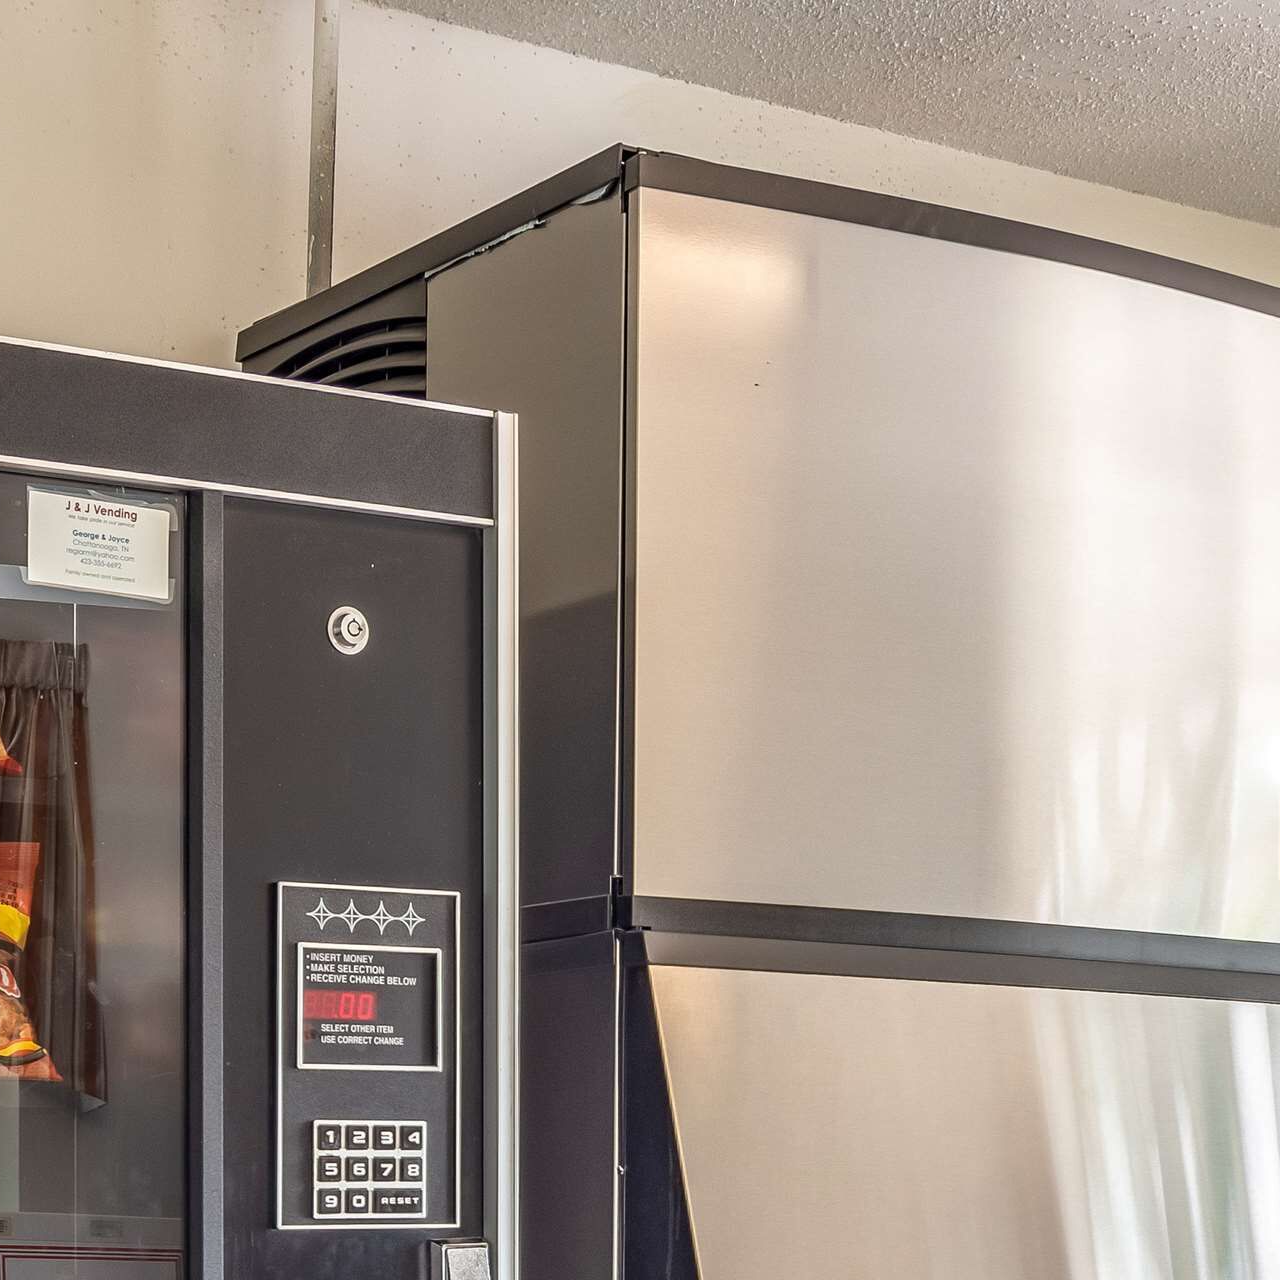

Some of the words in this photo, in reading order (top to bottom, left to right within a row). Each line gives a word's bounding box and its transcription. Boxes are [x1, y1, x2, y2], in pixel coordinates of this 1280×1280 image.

[65, 501, 71, 510] J
[74, 502, 81, 512] &
[84, 503, 90, 513] J
[94, 504, 138, 522] Vending
[72, 529, 99, 540] George
[108, 534, 130, 544] Joyce
[311, 953, 342, 962] INSERT
[343, 954, 374, 964] MONEY
[311, 963, 336, 973] MAKE
[337, 964, 385, 974] SELECTION
[311, 973, 348, 983] RECEIVE
[349, 975, 385, 985] CHANGE
[387, 976, 417, 986] BELOW
[320, 1023, 349, 1033] SELECT
[350, 1024, 376, 1033] OTHER
[376, 1025, 394, 1034] ITEM
[320, 1035, 336, 1044] USE
[337, 1036, 372, 1045] CORRECT
[373, 1036, 405, 1046] CHANGE
[324, 1129, 336, 1144] 1
[352, 1131, 367, 1145] 2
[380, 1131, 394, 1145] 3
[407, 1132, 421, 1146] 4
[324, 1163, 338, 1176] 5
[352, 1163, 367, 1177] 6
[380, 1163, 393, 1176] 7
[407, 1163, 421, 1177] 8
[324, 1194, 338, 1209] 9
[352, 1194, 366, 1208] 0
[380, 1196, 420, 1205] RESET
